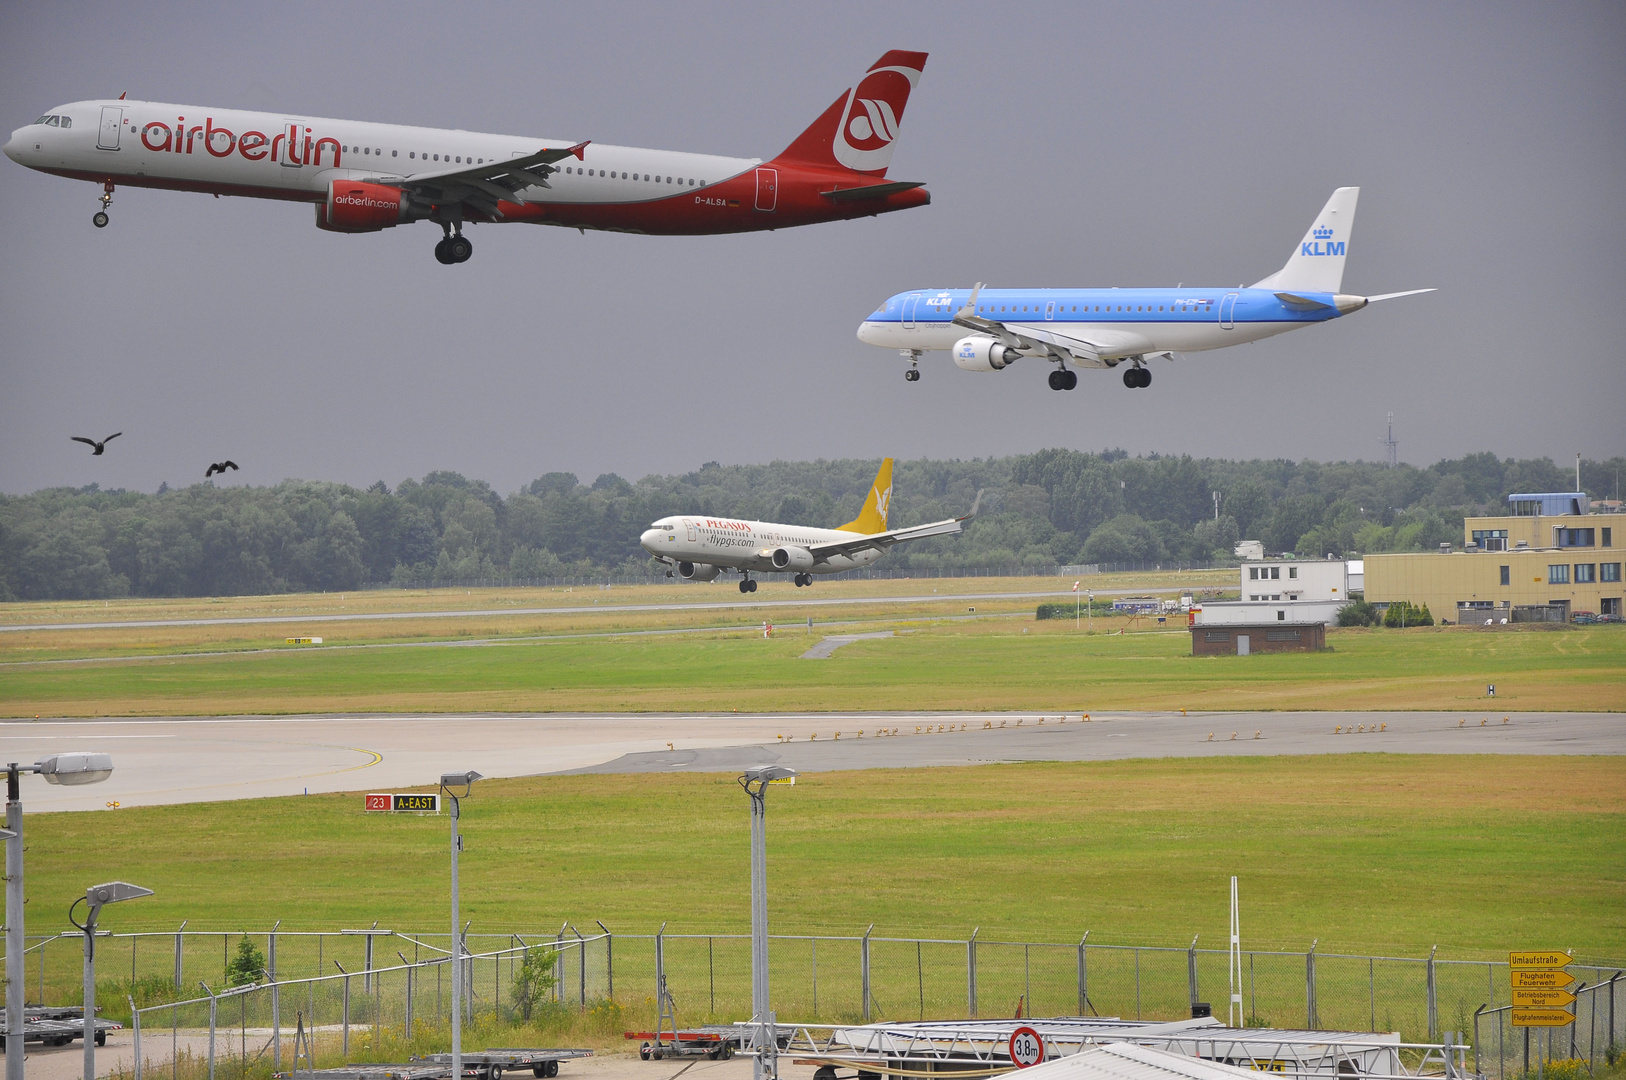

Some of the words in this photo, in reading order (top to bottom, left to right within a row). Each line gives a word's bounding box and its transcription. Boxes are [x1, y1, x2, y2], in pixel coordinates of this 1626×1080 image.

[140, 115, 341, 168] airberlin
[335, 194, 398, 210] airberlin.com
[695, 196, 726, 206] D-ALSA
[1301, 241, 1345, 256] KLM
[926, 297, 953, 306] KLM
[706, 519, 752, 533] PEGASUS
[710, 534, 755, 548] flypgs.com
[372, 797, 385, 809] 23
[398, 797, 433, 809] A-EAST
[1512, 955, 1559, 965] Umlaufstraße
[1520, 972, 1555, 980] Flughafen
[1517, 991, 1560, 999] Betriebsbereich
[1513, 1014, 1565, 1022] Flughafenmeisterei
[1016, 1039, 1038, 1057] 3,8m
